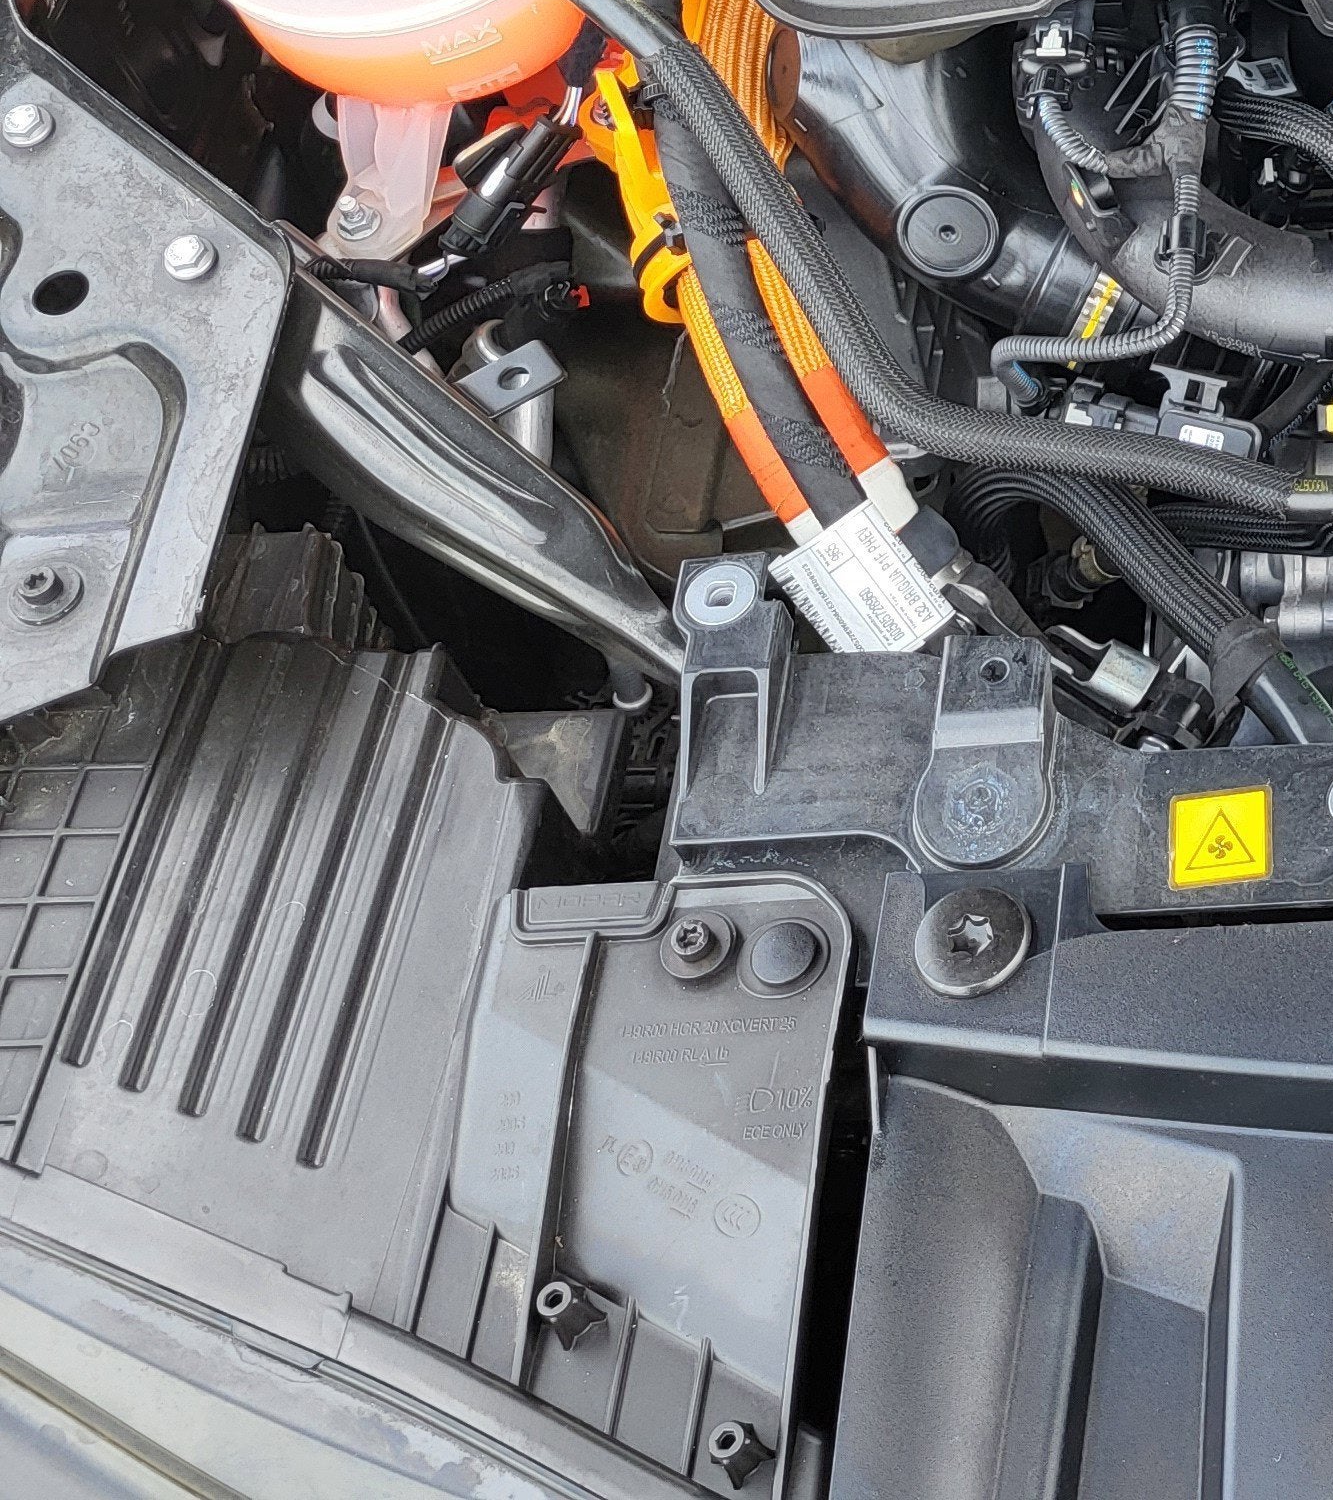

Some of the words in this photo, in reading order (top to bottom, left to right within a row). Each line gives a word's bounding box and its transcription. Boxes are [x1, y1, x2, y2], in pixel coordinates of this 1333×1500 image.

[420, 19, 497, 57] MAX
[912, 600, 935, 624] A32
[743, 1124, 770, 1140] ECE
[772, 1121, 809, 1140] ONLY
